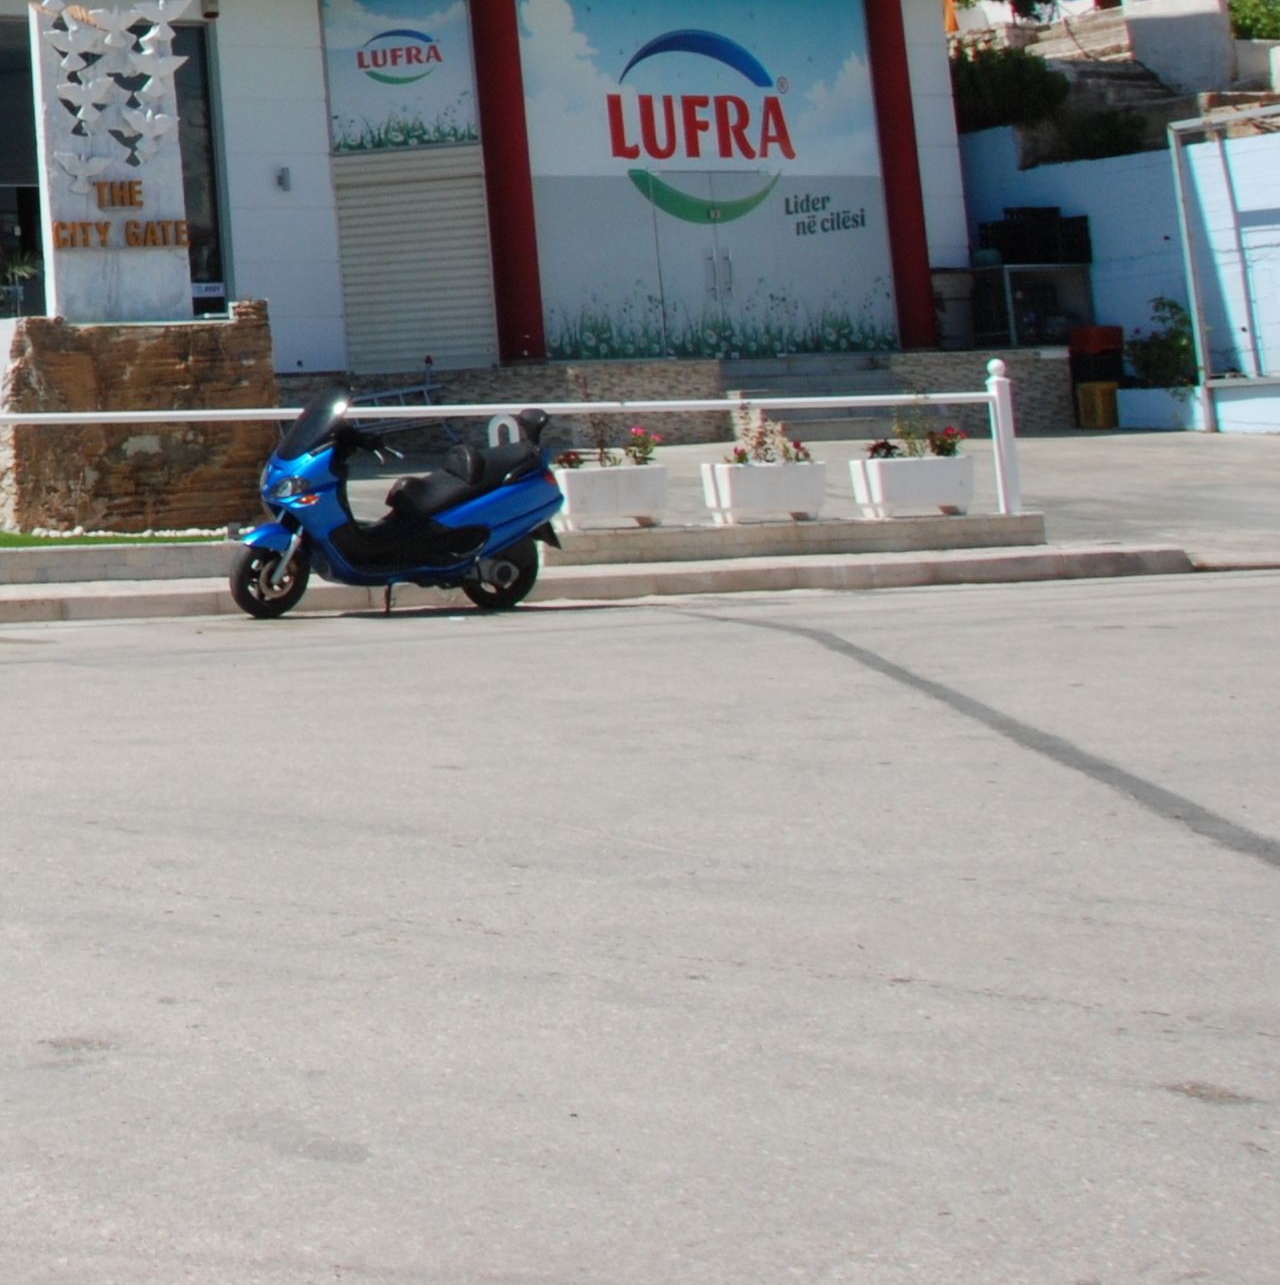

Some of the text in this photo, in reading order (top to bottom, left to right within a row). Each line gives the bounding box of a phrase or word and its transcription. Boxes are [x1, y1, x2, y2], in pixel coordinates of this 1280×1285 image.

[356, 44, 443, 69] LUFRA
[606, 94, 796, 160] LUFRA
[92, 180, 144, 208] THE
[784, 192, 831, 216] Lider
[53, 219, 192, 247] CITY GATE
[796, 208, 866, 236] në cilësi
